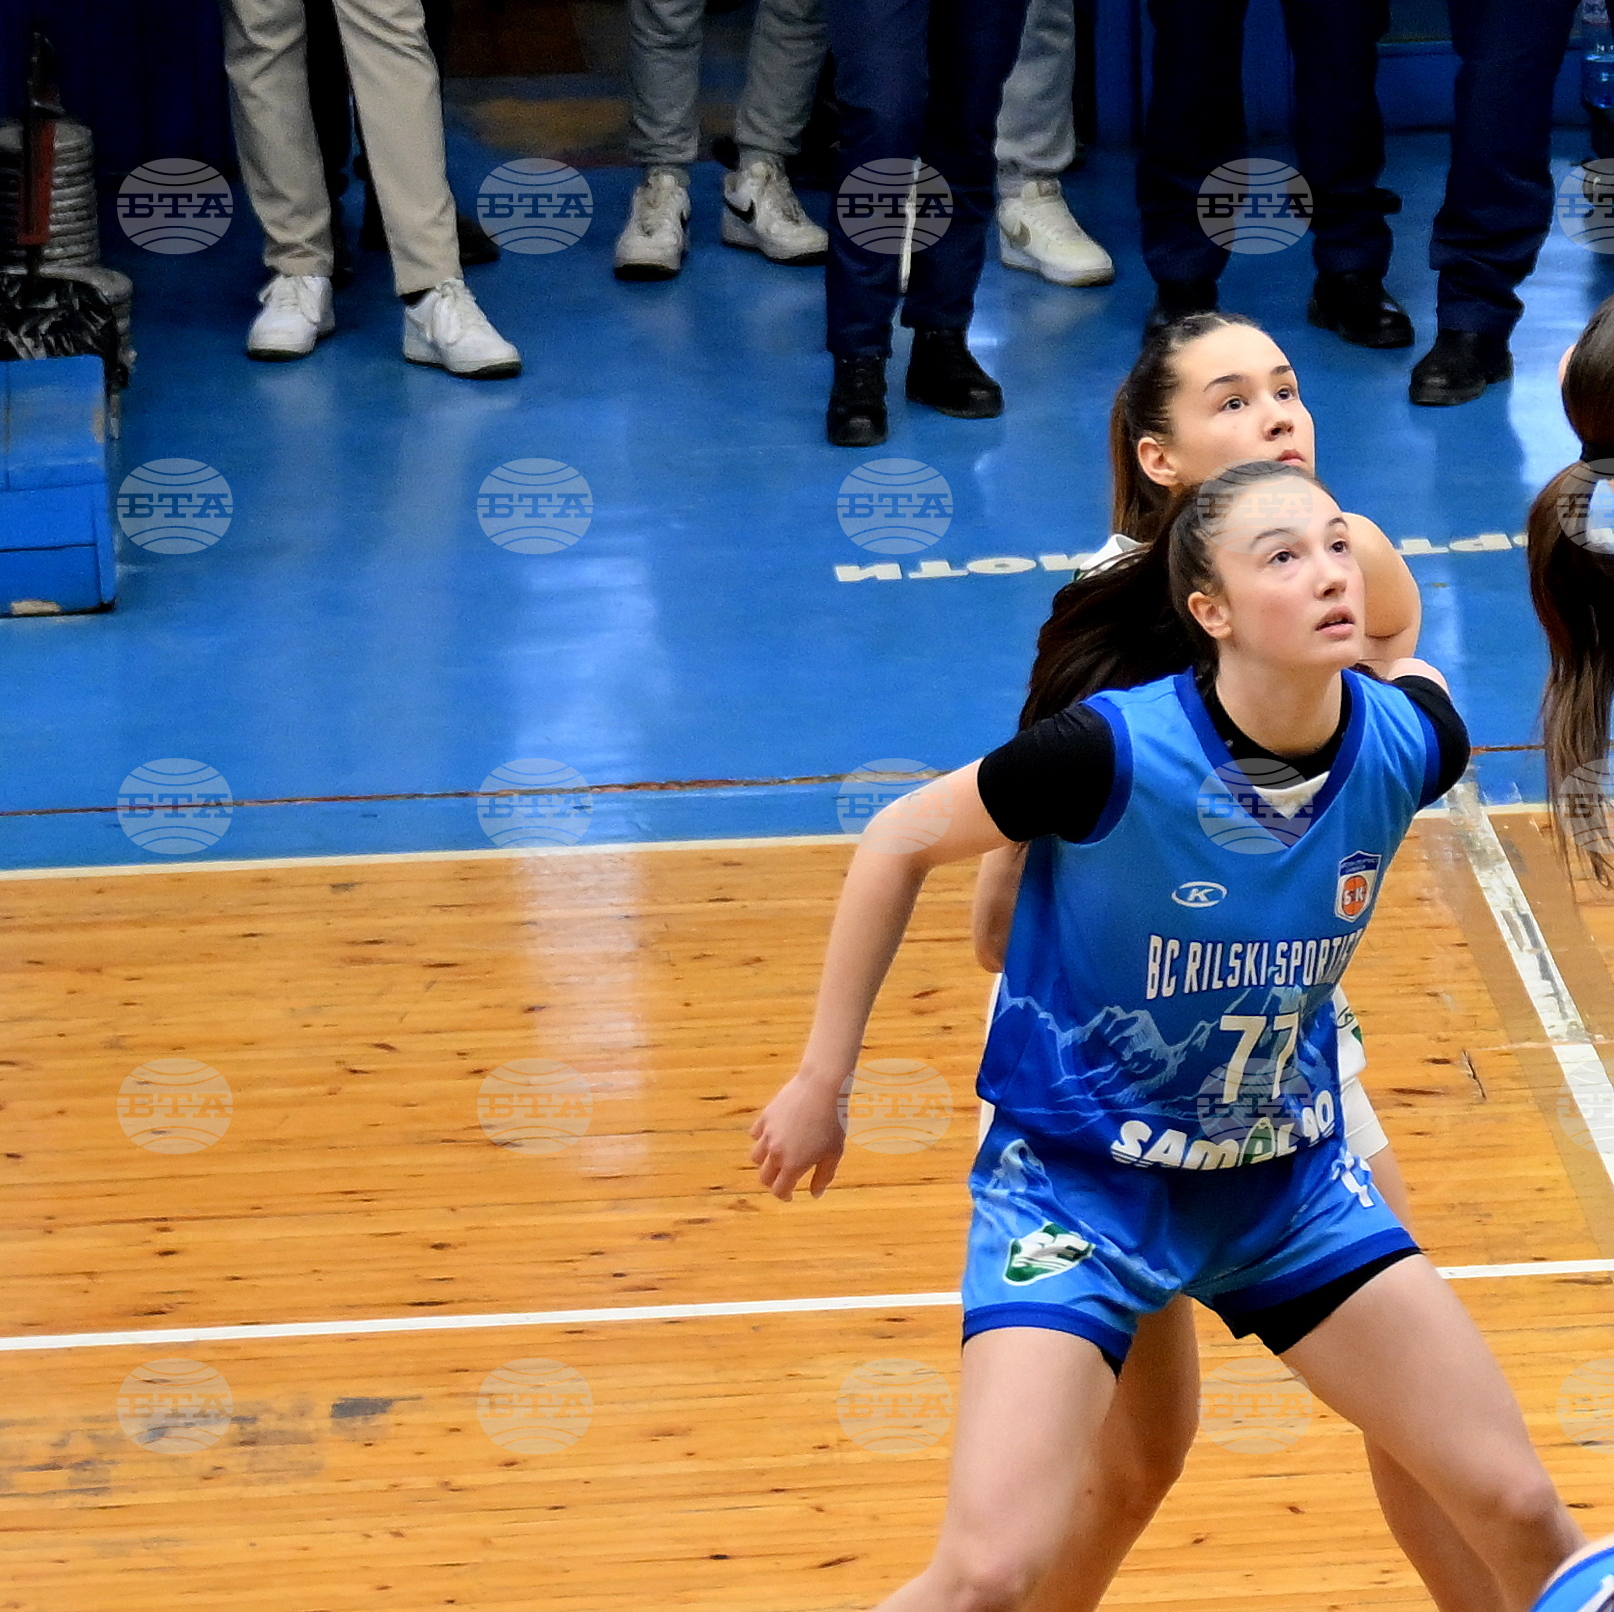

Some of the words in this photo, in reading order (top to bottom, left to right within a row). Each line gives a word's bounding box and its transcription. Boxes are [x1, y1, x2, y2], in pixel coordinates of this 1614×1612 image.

[1146, 933, 1181, 1000] BC
[1184, 941, 1270, 994] RILSKI
[1219, 1012, 1300, 1105] 77
